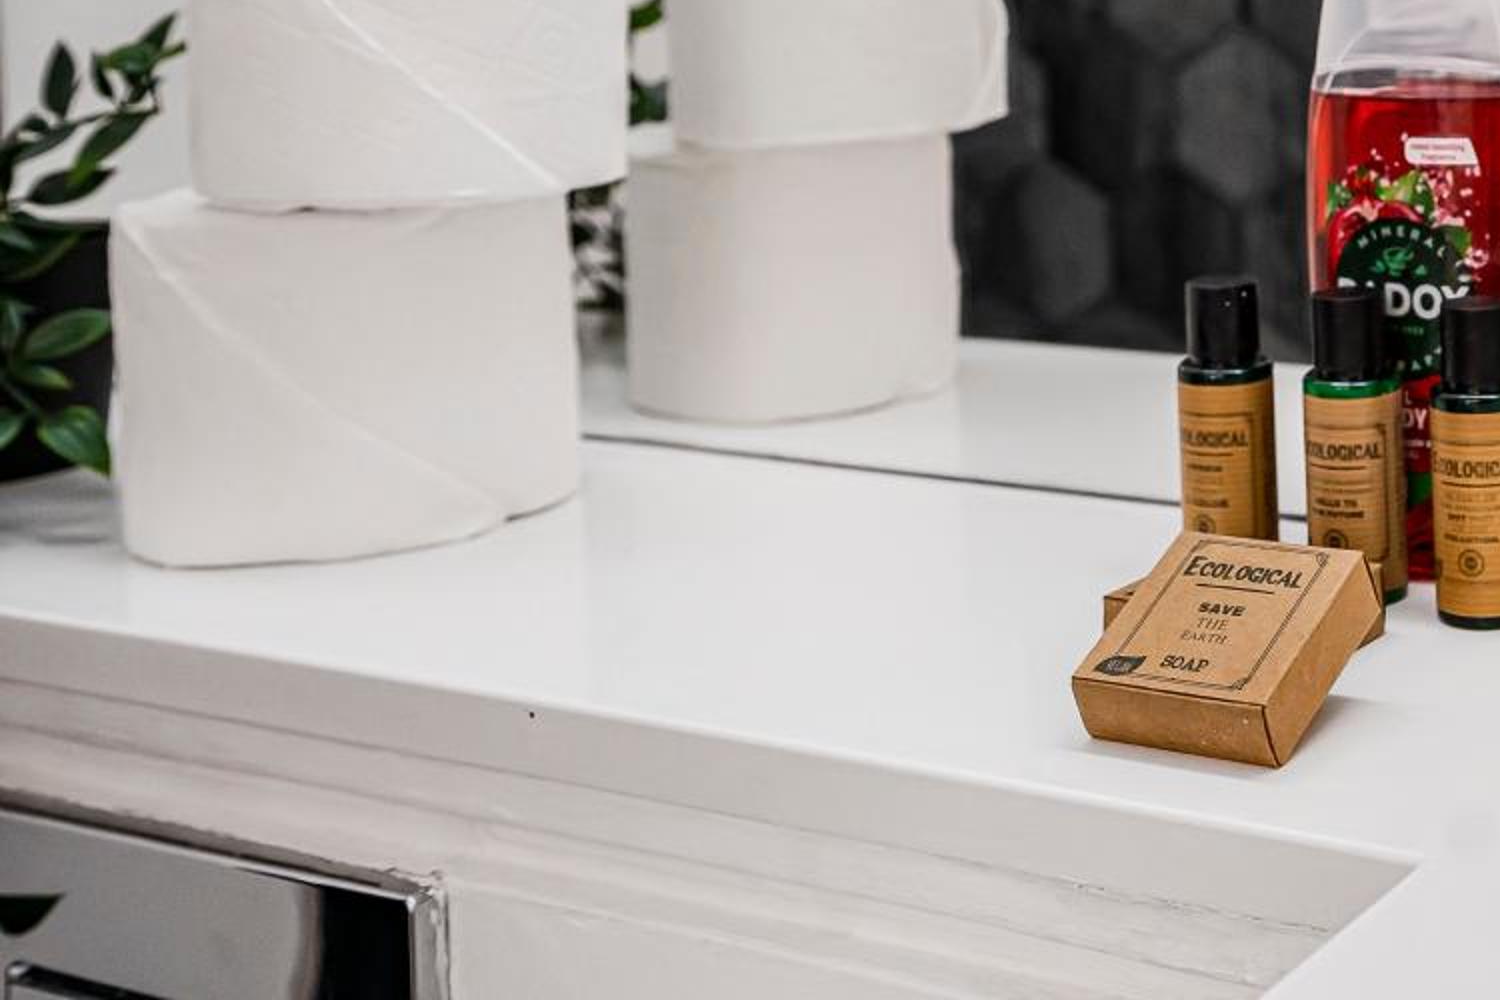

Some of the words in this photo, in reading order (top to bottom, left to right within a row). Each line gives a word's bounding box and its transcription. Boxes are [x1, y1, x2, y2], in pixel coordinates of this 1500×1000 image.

[1183, 555, 1303, 588] ECOLOGICAL
[1198, 601, 1246, 617] SAVE
[1196, 617, 1229, 631] THE
[1180, 630, 1228, 645] EARTH
[1159, 654, 1210, 673] SOAP
